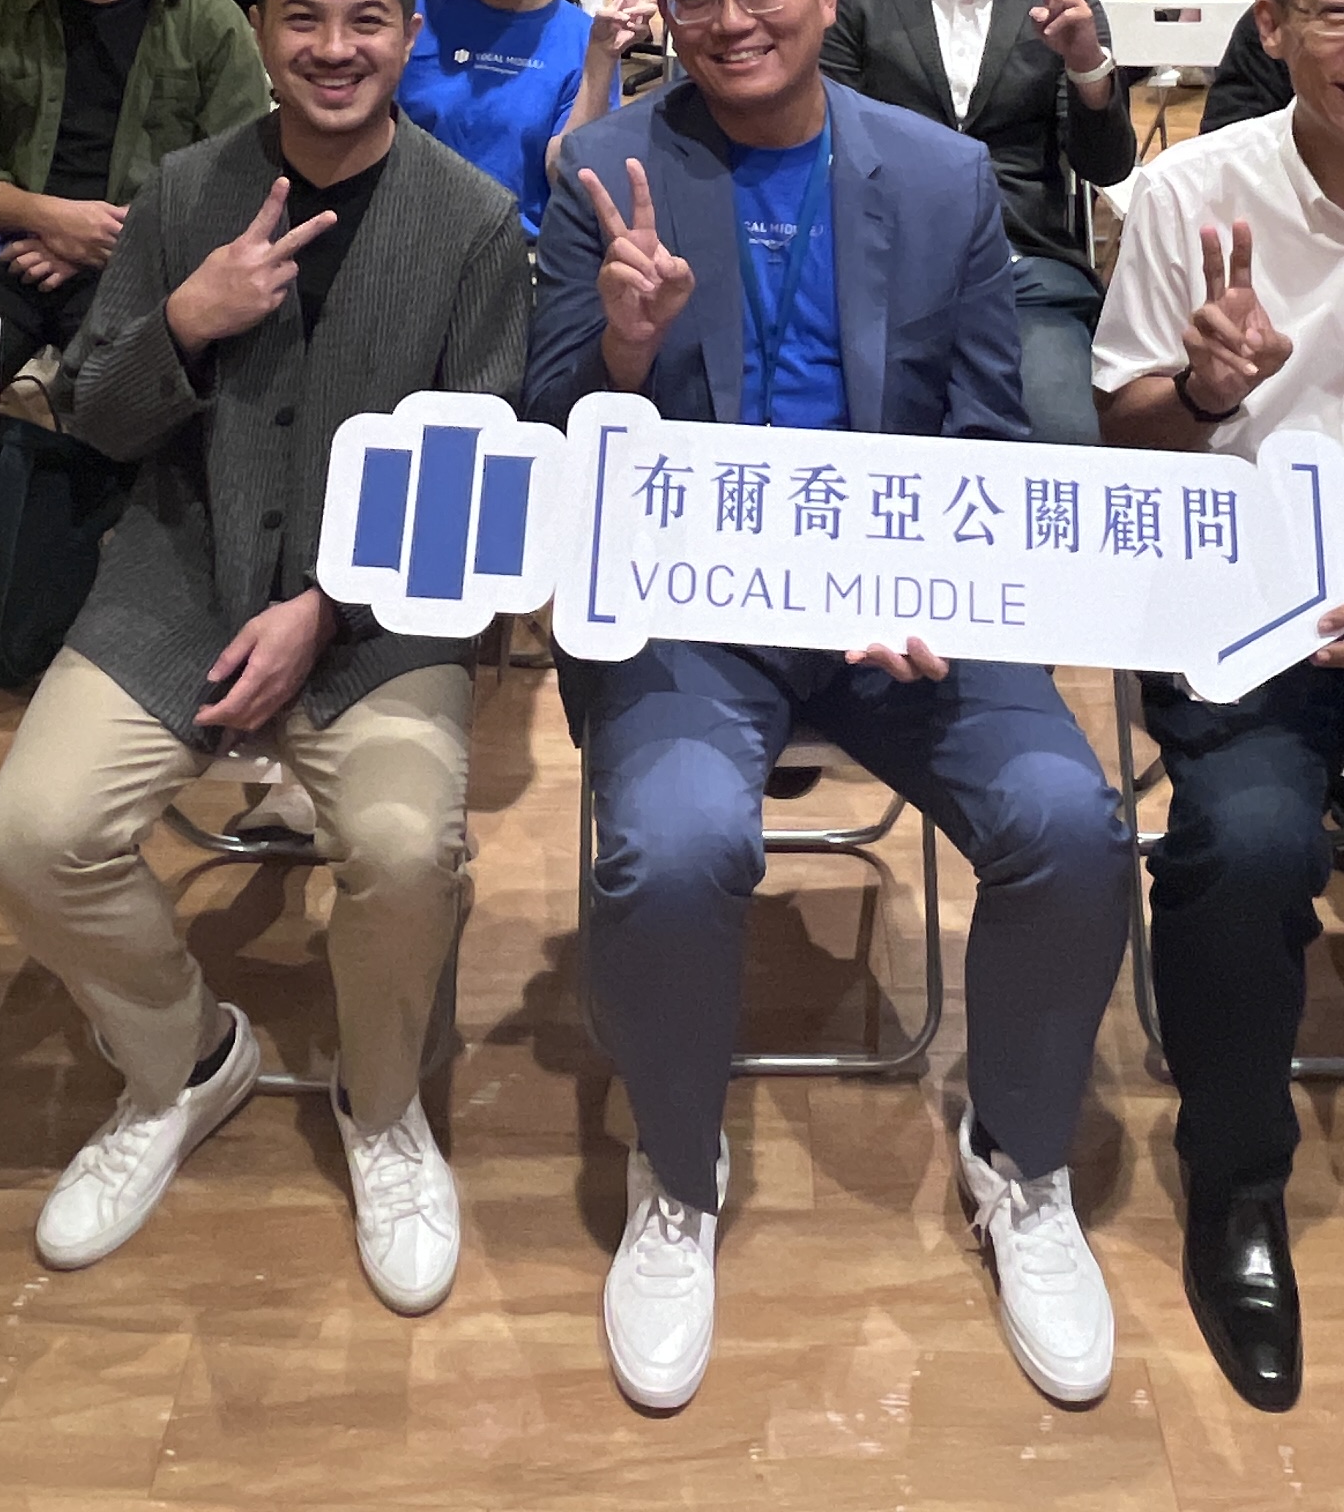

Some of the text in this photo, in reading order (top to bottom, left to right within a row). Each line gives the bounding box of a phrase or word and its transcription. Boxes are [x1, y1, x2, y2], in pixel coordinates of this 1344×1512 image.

[631, 453, 1239, 564] 布爾喬亞公關顧問
[630, 560, 1026, 626] VOCAL MIDDLE
